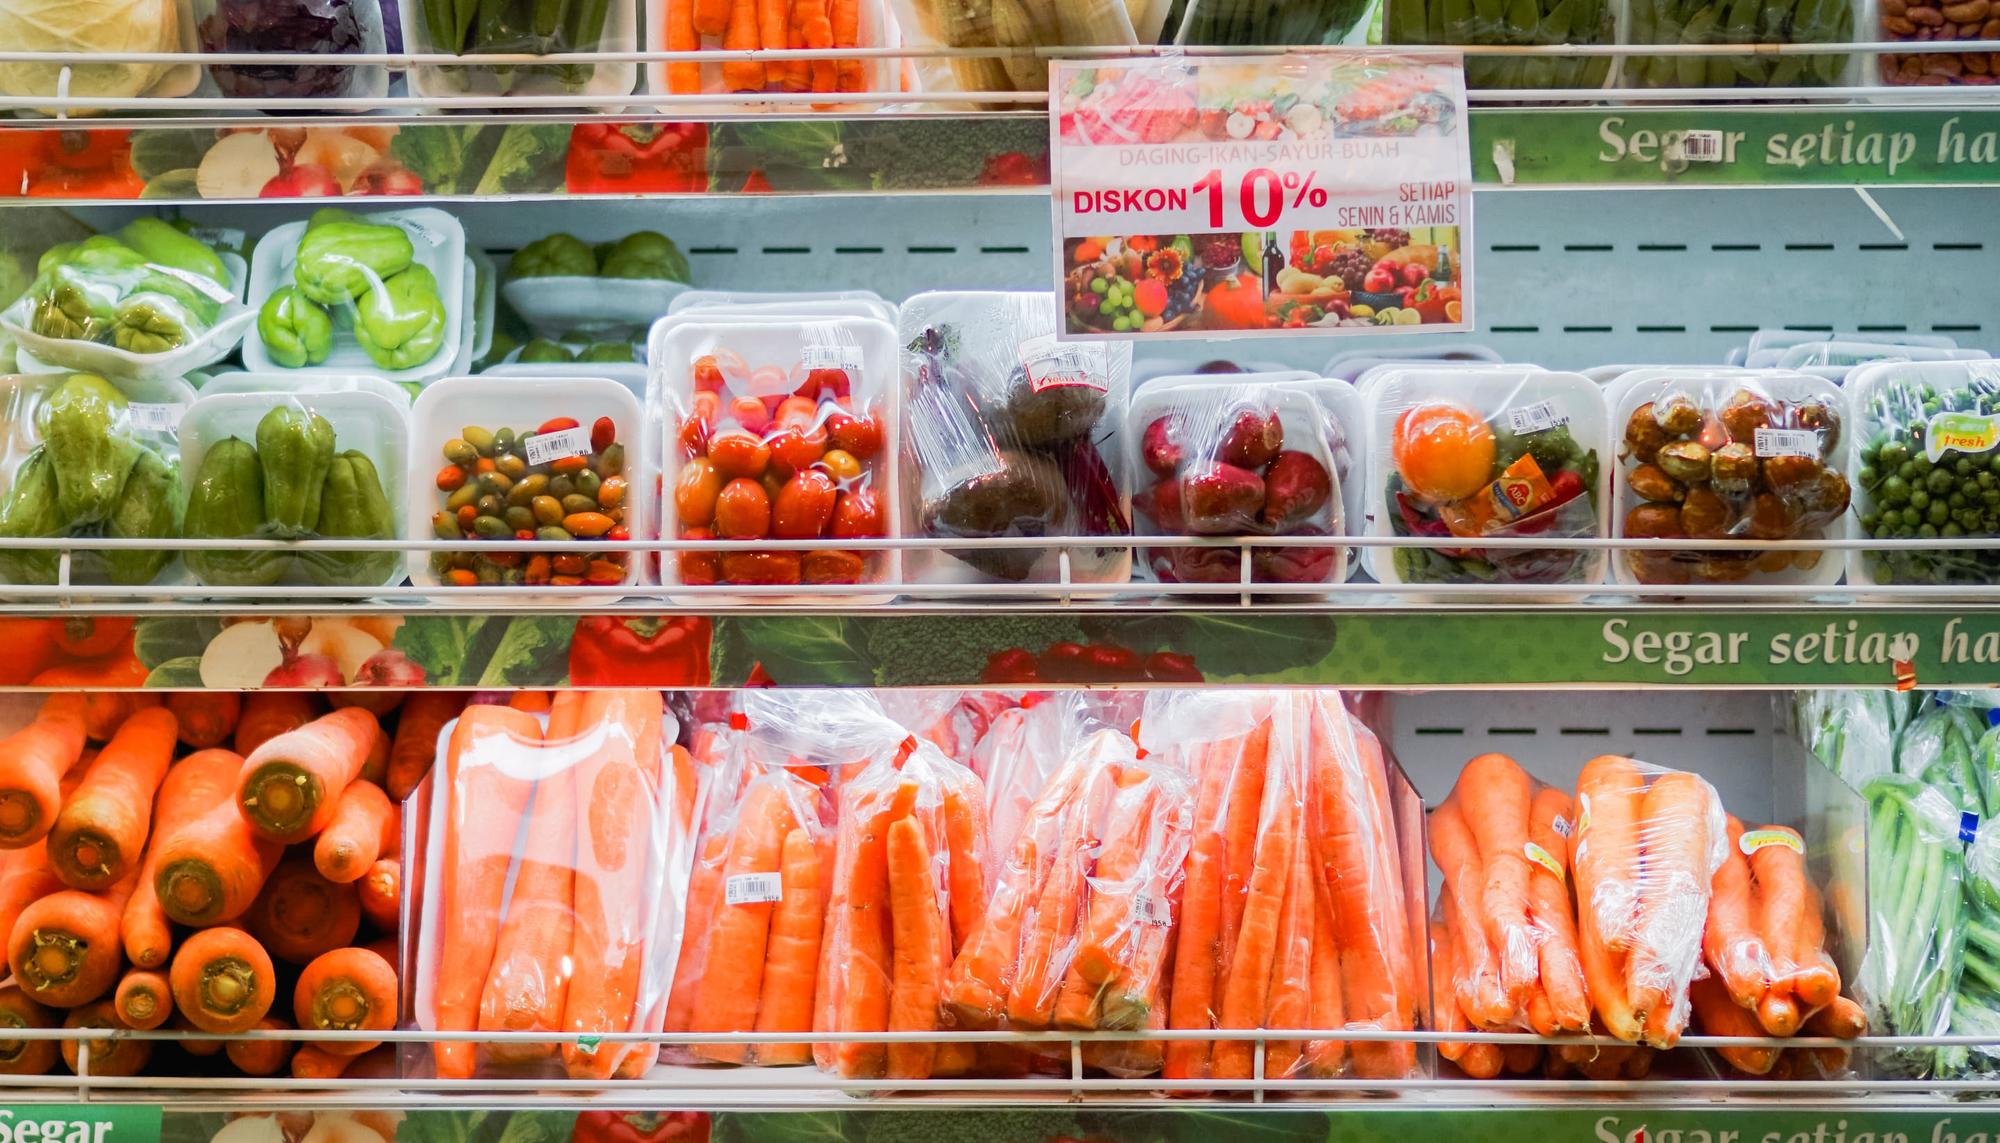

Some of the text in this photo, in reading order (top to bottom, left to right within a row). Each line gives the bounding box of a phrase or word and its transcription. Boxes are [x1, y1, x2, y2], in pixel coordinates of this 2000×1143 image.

[1119, 142, 1400, 166] DAGING-IKAN-SAYUR-BUAH
[1599, 117, 1746, 173] Segr
[1765, 120, 1916, 175] setiap
[1074, 167, 1328, 228] DISKON 10%
[1399, 181, 1455, 202] SETIAP
[1338, 203, 1455, 227] SENIN & KAMIS
[1944, 434, 1985, 448] fresh
[1508, 486, 1526, 504] ABC
[1603, 618, 1749, 675] Segar
